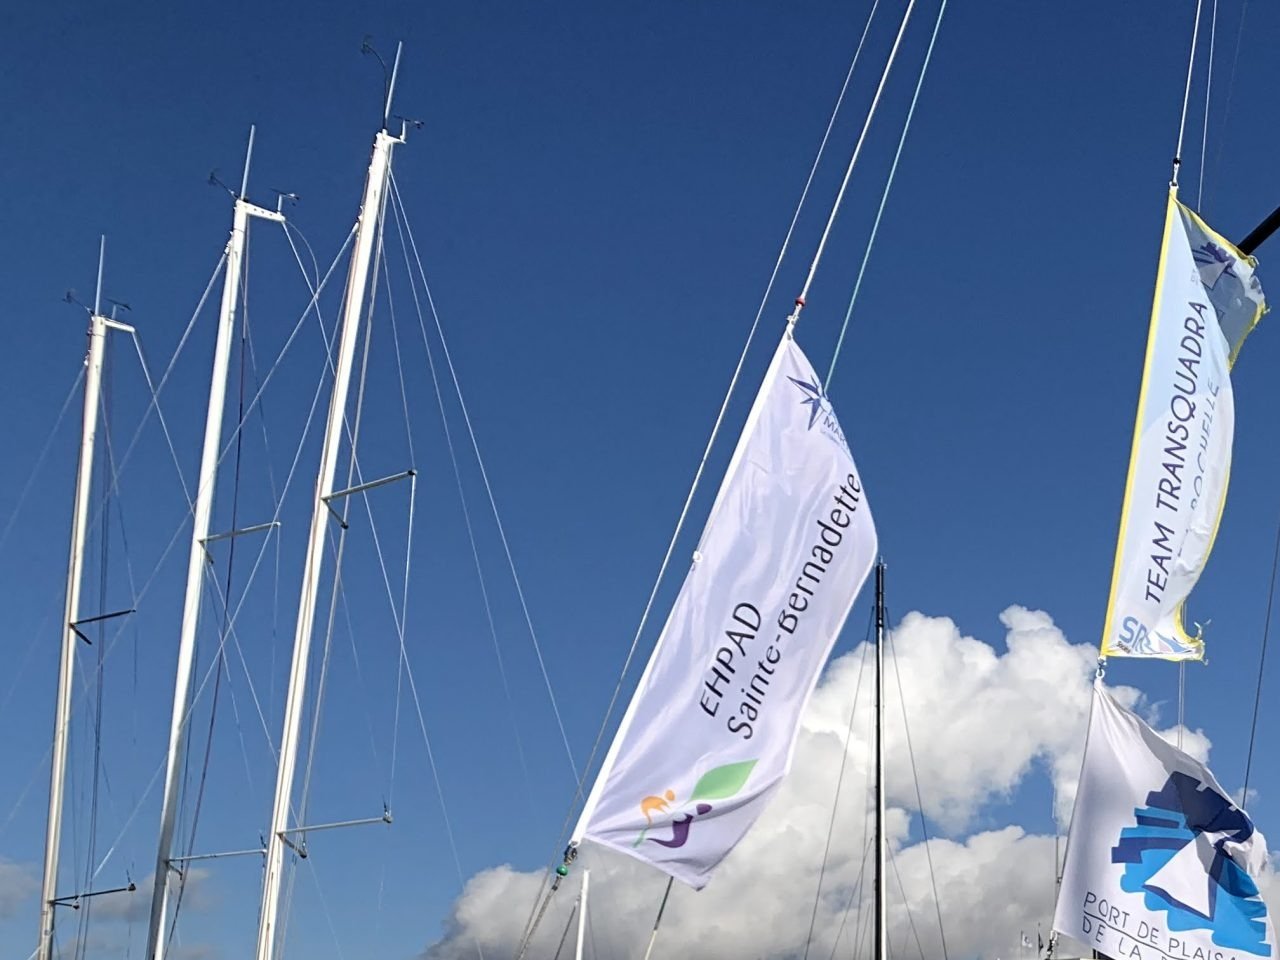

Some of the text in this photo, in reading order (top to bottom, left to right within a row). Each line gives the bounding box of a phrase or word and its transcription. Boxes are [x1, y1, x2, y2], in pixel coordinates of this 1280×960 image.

[1145, 301, 1208, 604] TEAM TRANSQUADRA
[699, 602, 762, 718] EHPAD
[727, 473, 862, 740] Sainte-Bernadette
[1082, 915, 1106, 943] DE
[1083, 891, 1130, 929] PORT
[1137, 920, 1160, 943] DE
